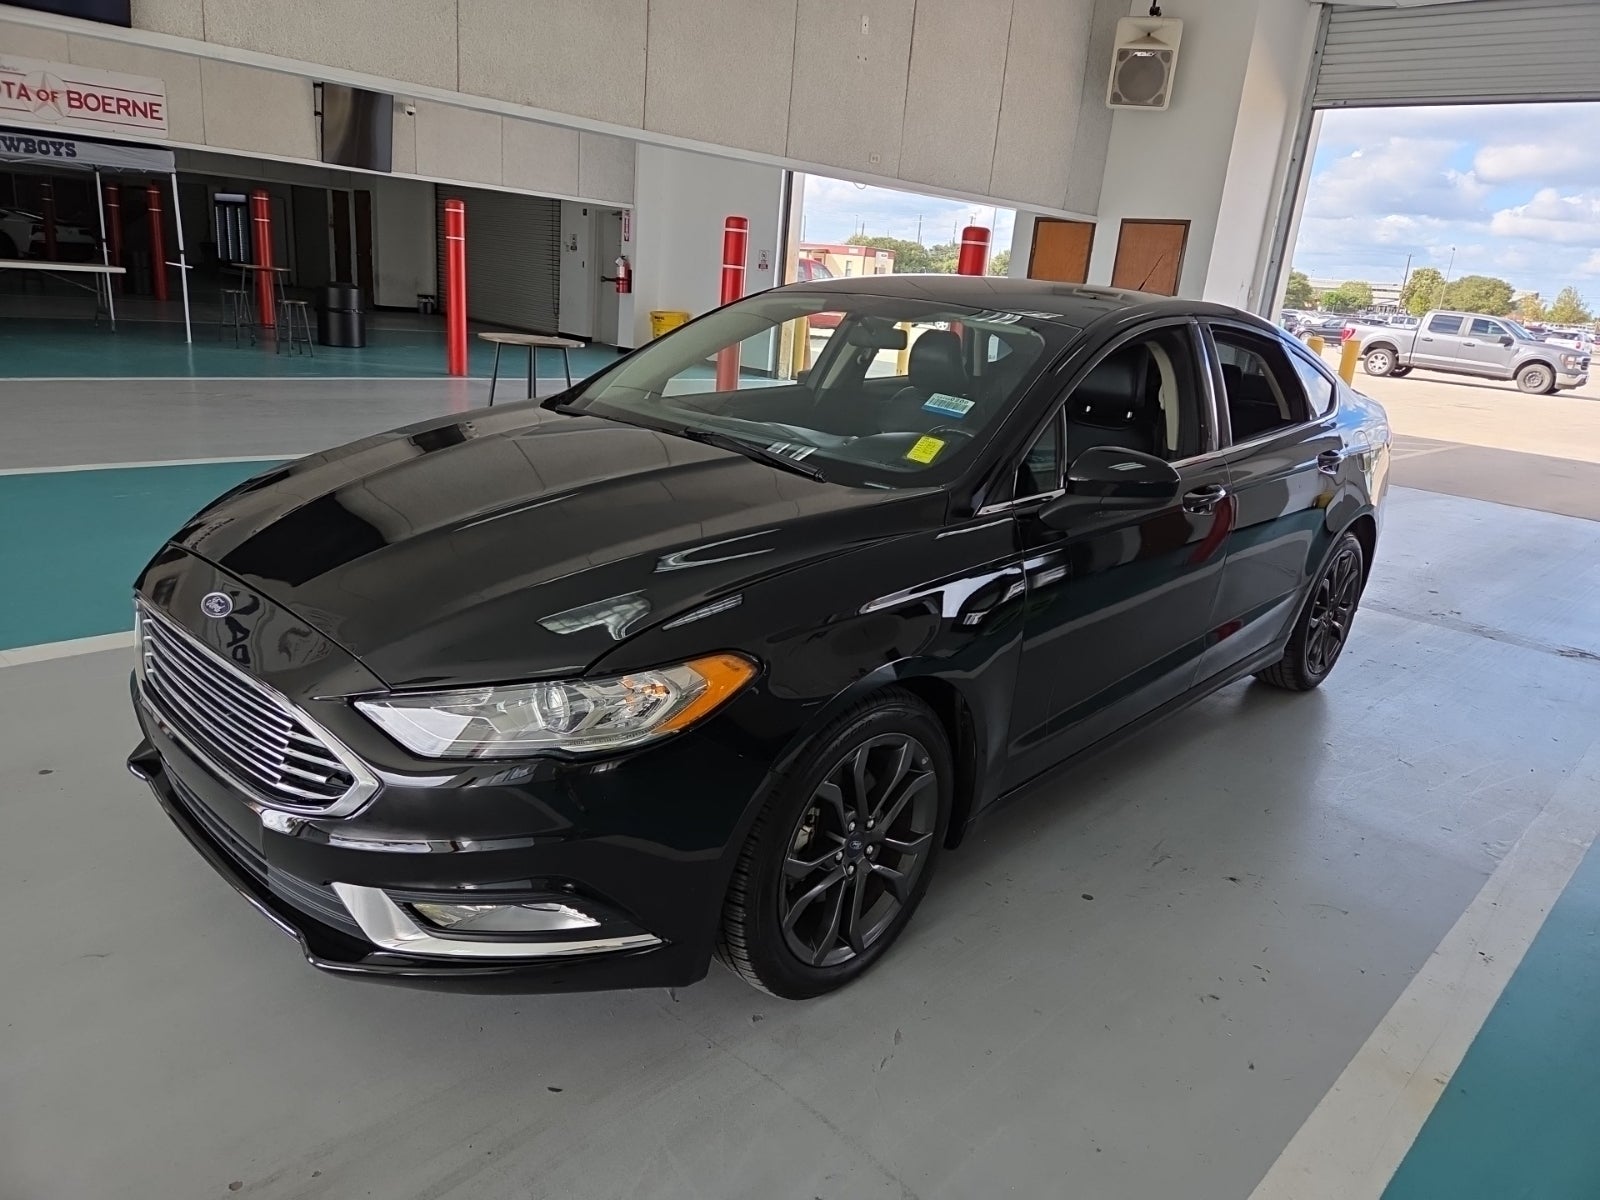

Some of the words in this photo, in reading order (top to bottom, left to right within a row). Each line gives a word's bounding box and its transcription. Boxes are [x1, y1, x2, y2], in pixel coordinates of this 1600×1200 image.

[0, 80, 32, 102] TA
[36, 89, 59, 103] OF
[66, 89, 164, 121] BOERNE
[0, 135, 77, 158] WBOYS
